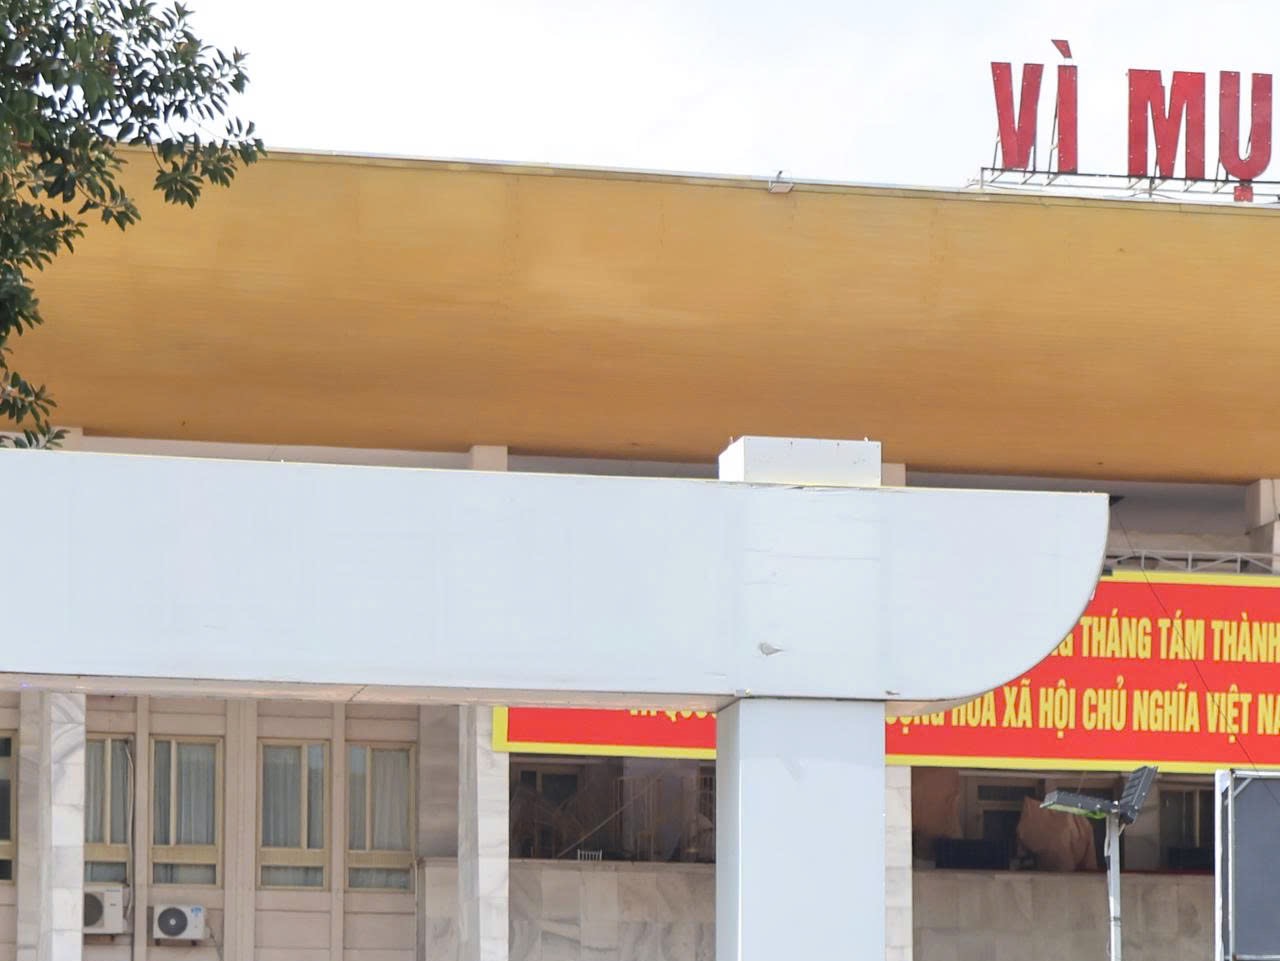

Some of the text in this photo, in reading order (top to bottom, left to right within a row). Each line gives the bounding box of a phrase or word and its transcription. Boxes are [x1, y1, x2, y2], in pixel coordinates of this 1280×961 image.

[991, 39, 1078, 174] VÌ
[1080, 608, 1152, 660] THÁNG
[1158, 609, 1206, 661] TÁM
[1002, 678, 1033, 728] XÃ
[1039, 679, 1076, 739] HỘI
[1082, 675, 1128, 732] CHỦ
[1133, 682, 1200, 733] NGHĨA
[1206, 683, 1252, 744] VIỆT
